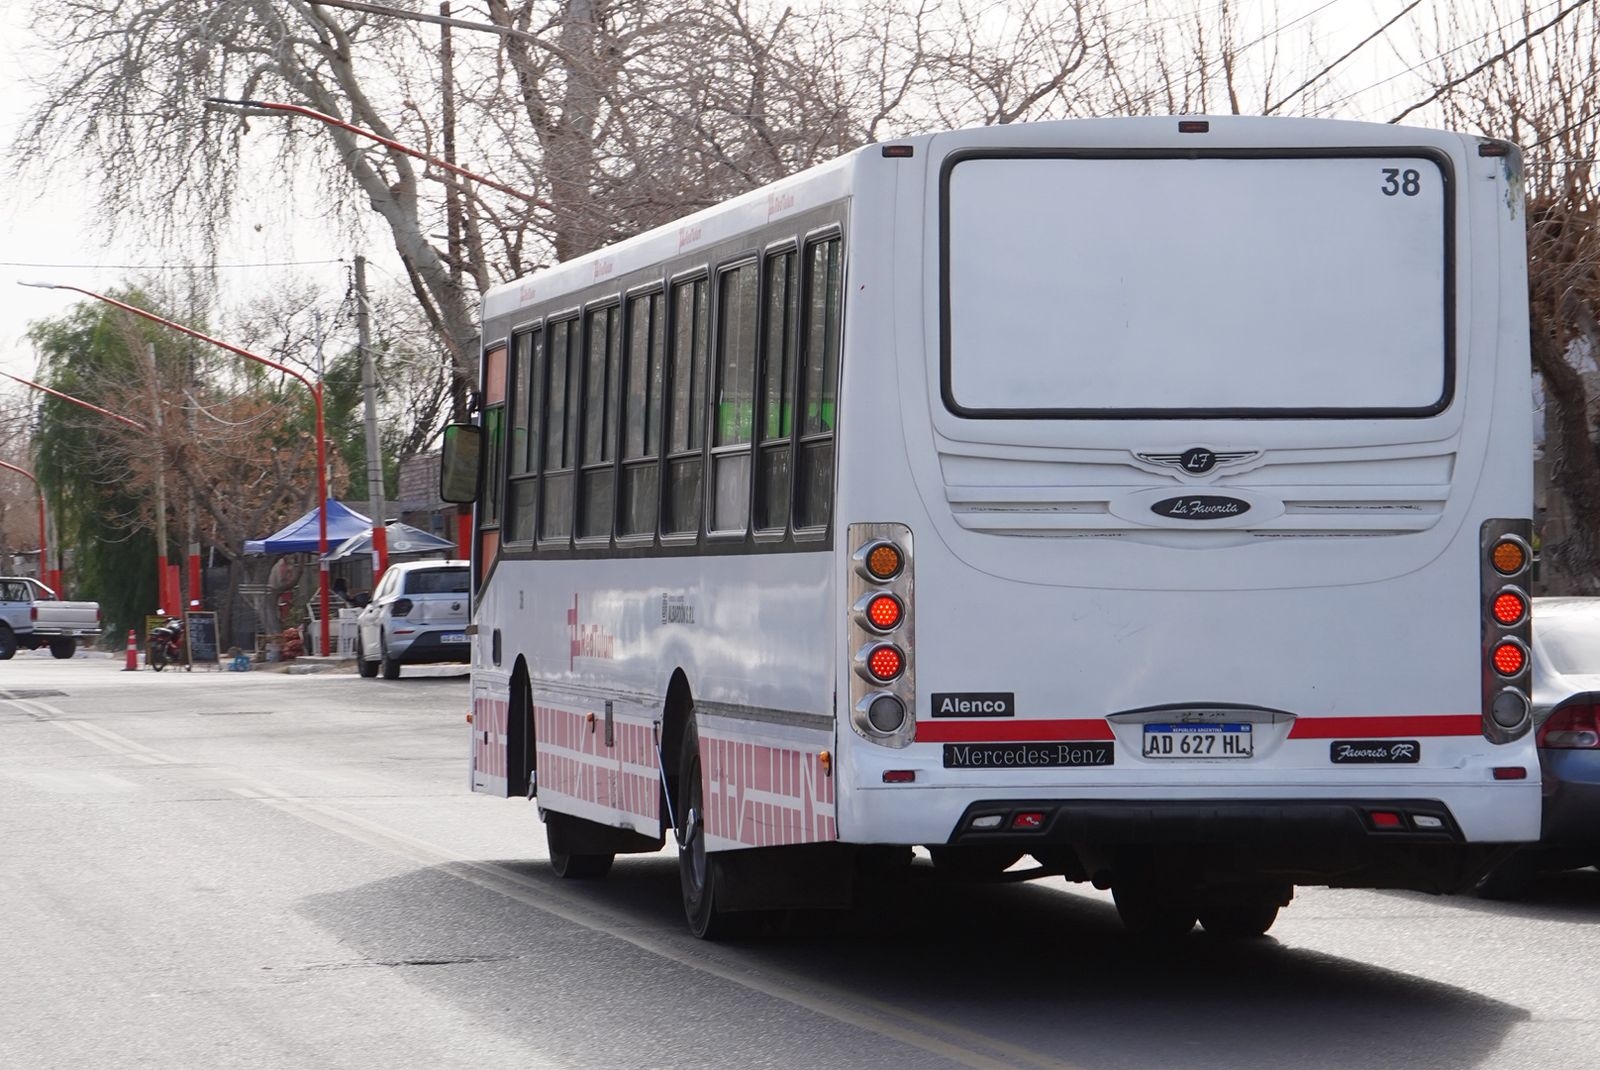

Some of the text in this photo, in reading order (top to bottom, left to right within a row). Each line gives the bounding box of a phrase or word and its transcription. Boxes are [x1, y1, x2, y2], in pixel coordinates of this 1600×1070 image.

[1381, 168, 1421, 197] 38
[1187, 453, 1210, 468] LF
[1169, 499, 1239, 516] La Favorita
[940, 697, 1006, 713] Alenco
[1149, 735, 1246, 755] AD 627 HL
[1337, 743, 1414, 761] Favorito GR
[951, 745, 1106, 766] Mercedes-Benz
